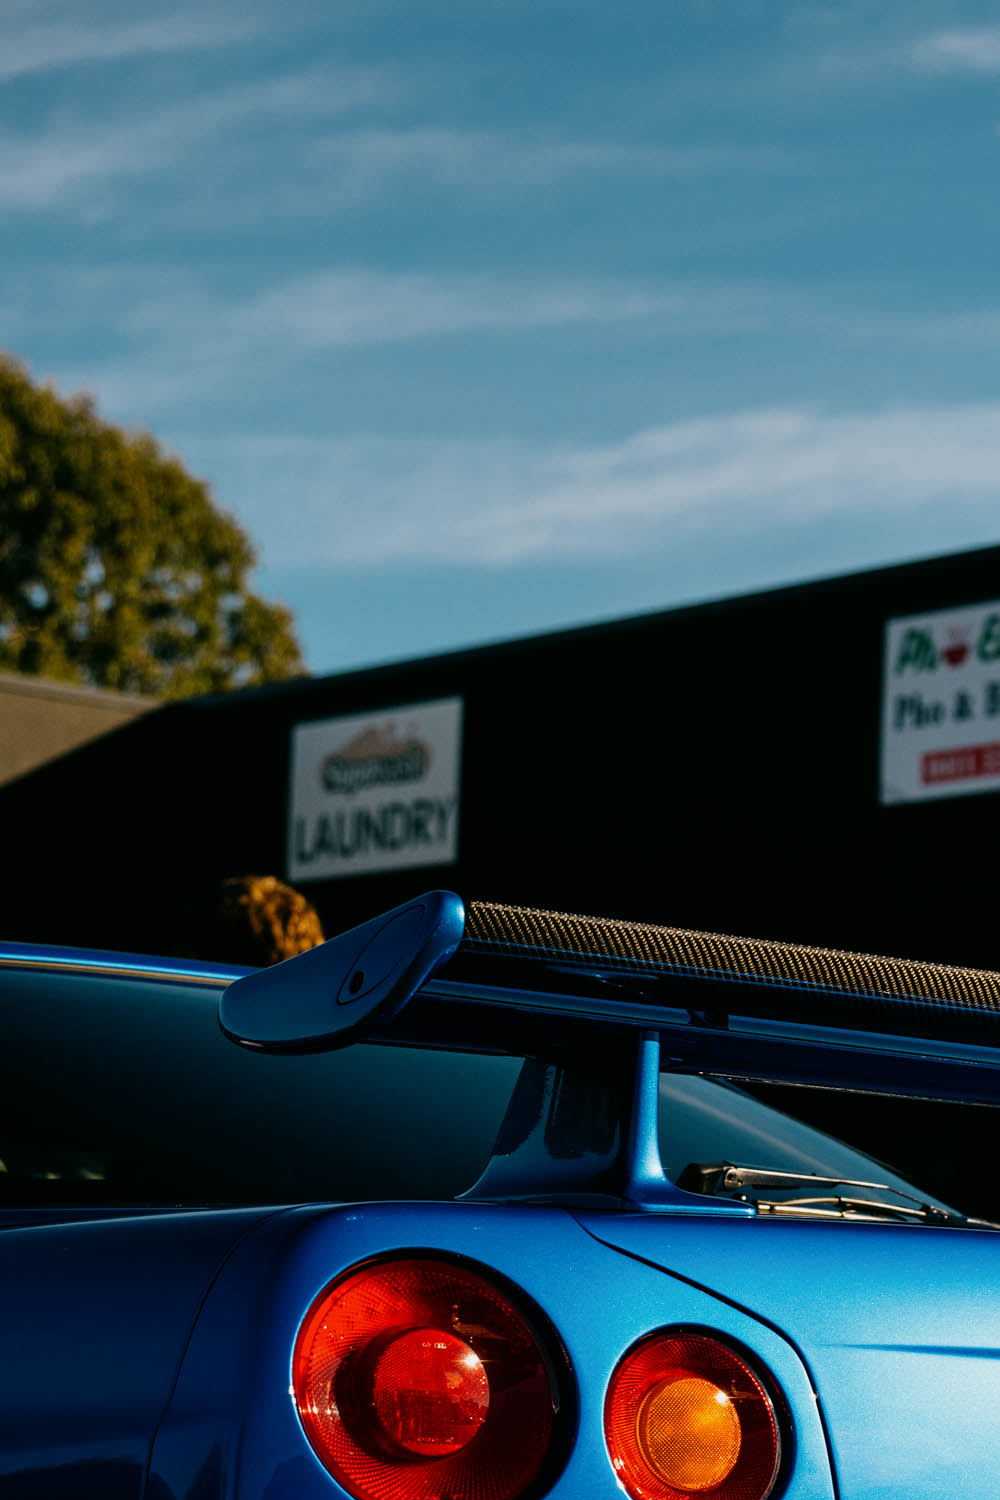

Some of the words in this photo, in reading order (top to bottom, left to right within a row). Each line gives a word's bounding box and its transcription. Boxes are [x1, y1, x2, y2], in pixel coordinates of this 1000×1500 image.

[895, 690, 944, 732] Pho
[953, 689, 975, 722] &
[296, 796, 458, 866] LAUNDRY
